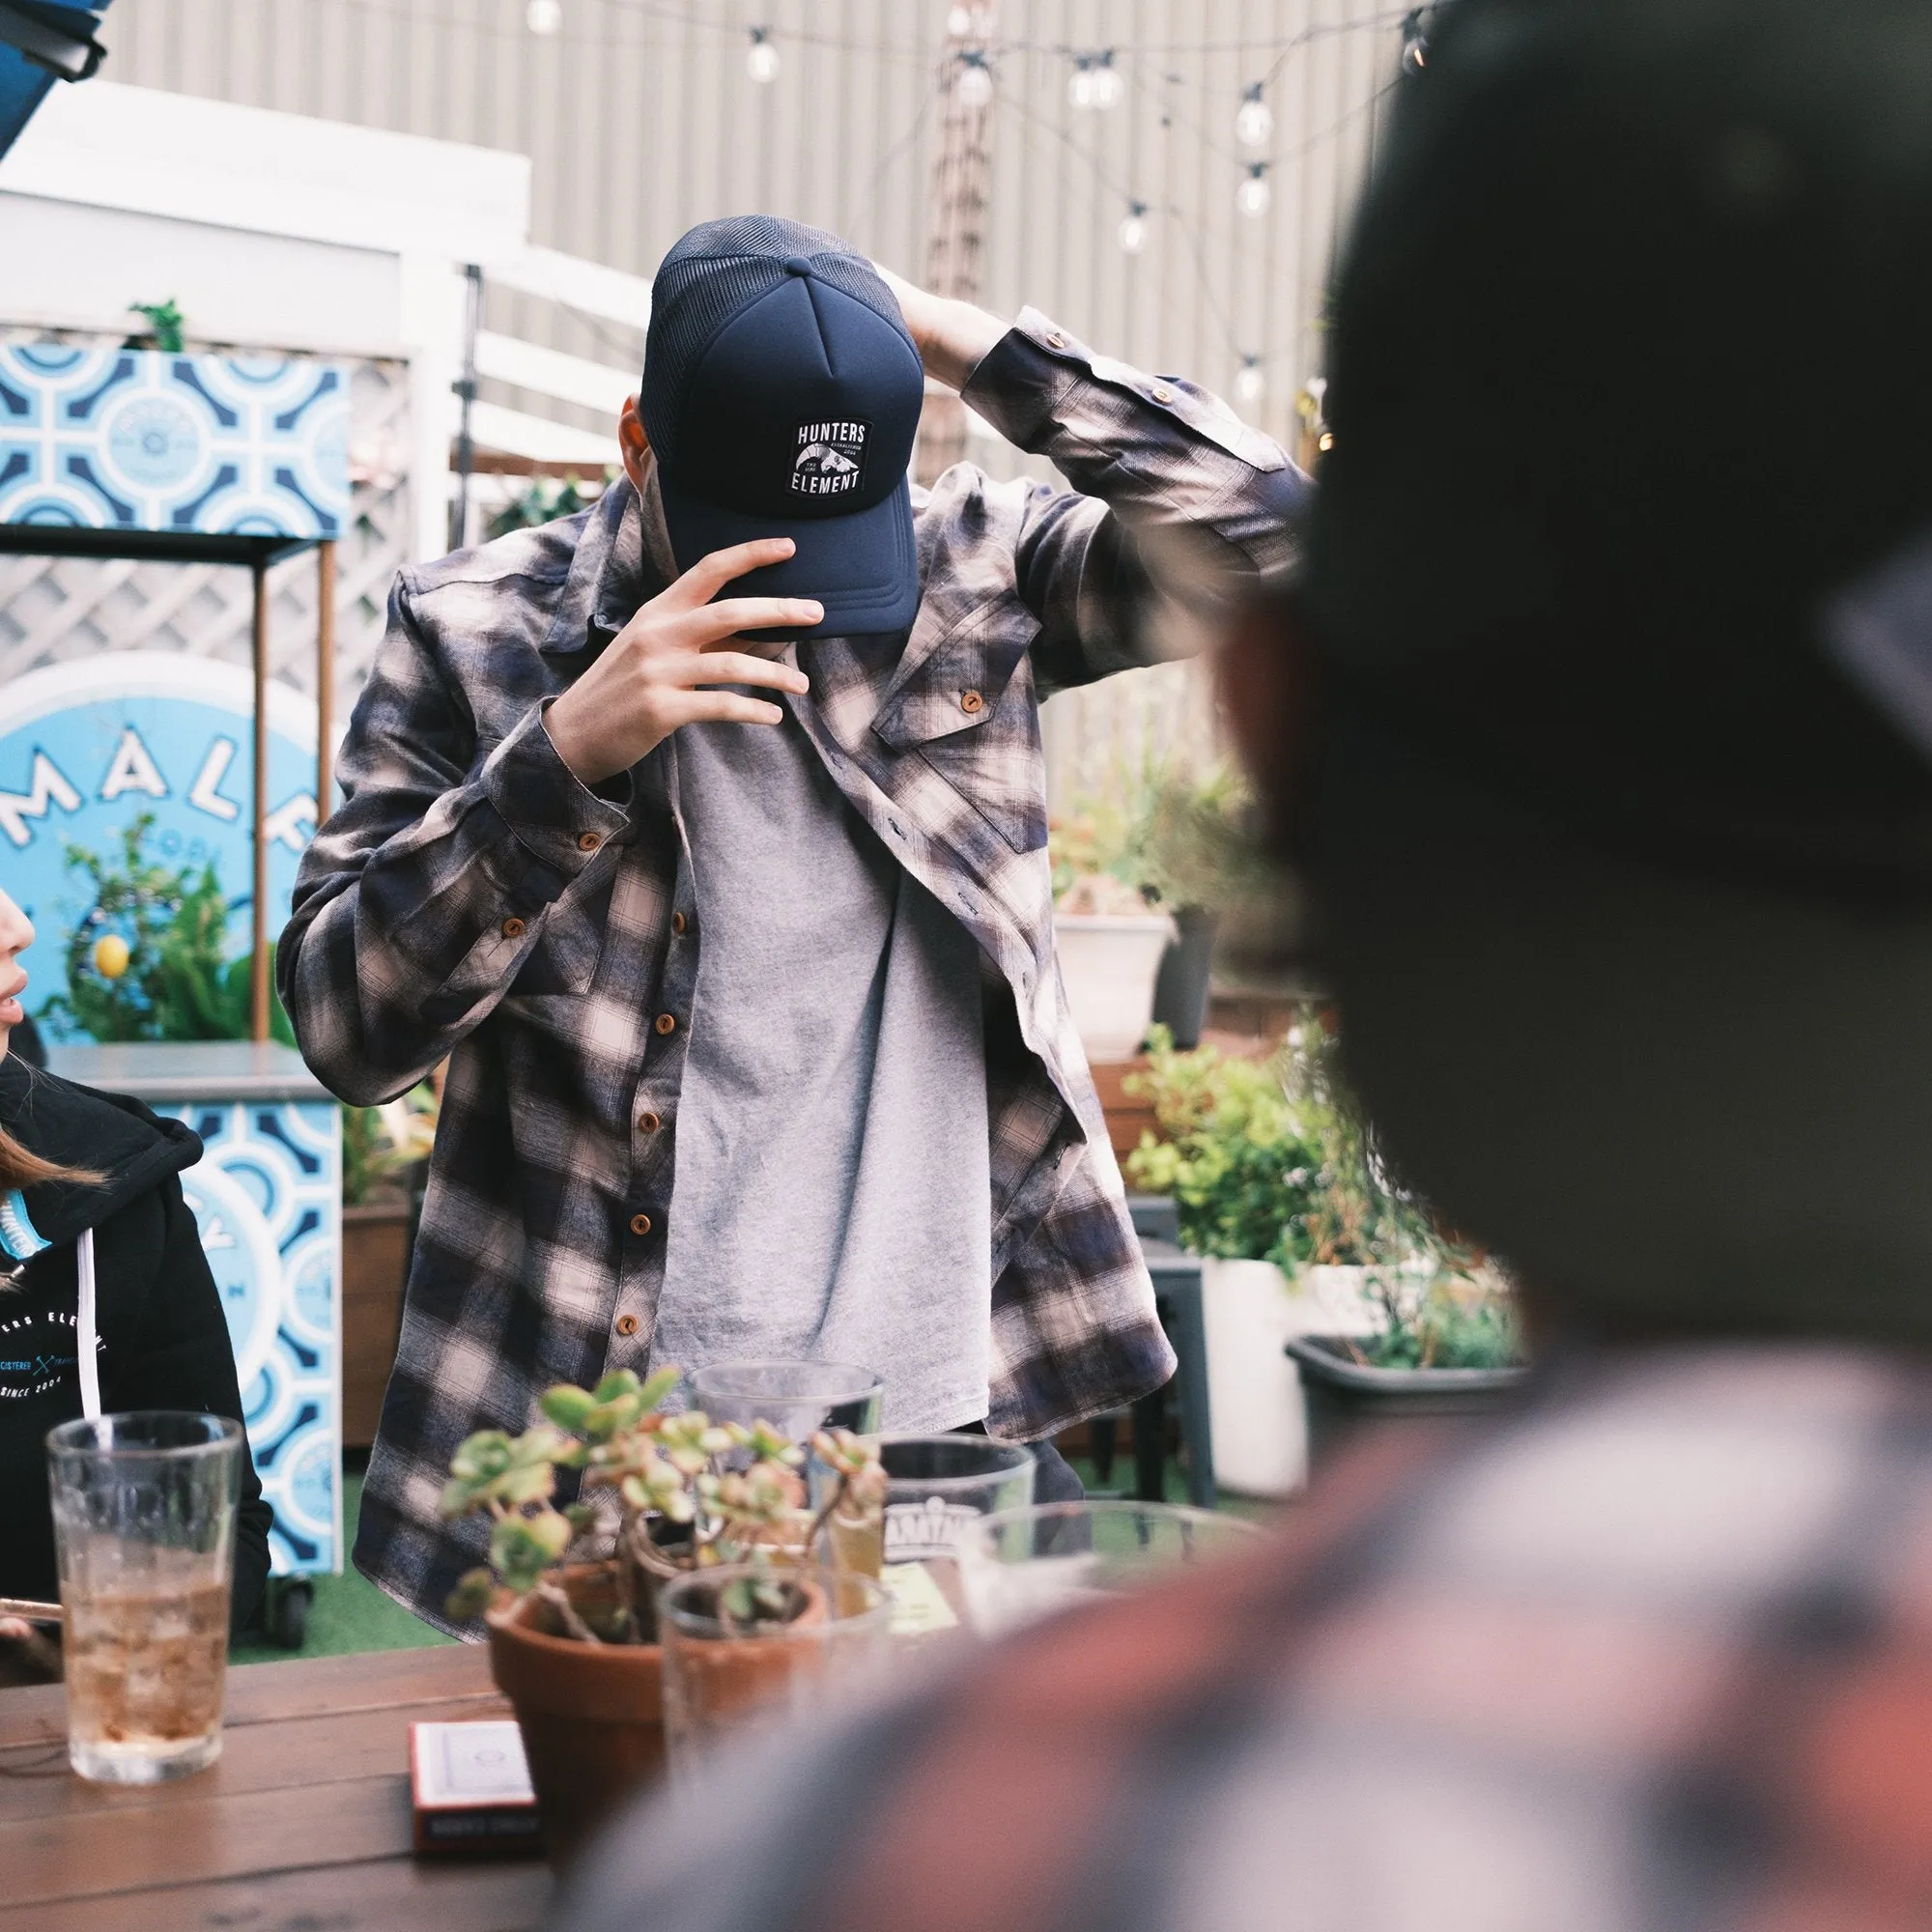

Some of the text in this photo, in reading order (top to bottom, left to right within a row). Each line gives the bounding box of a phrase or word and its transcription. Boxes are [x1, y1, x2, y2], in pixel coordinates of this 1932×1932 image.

[798, 422, 866, 444] HUNTERS
[791, 469, 860, 495] ELEMENT
[48, 1312, 107, 1351] ELENT
[1, 1376, 61, 1398] SINCE 2004
